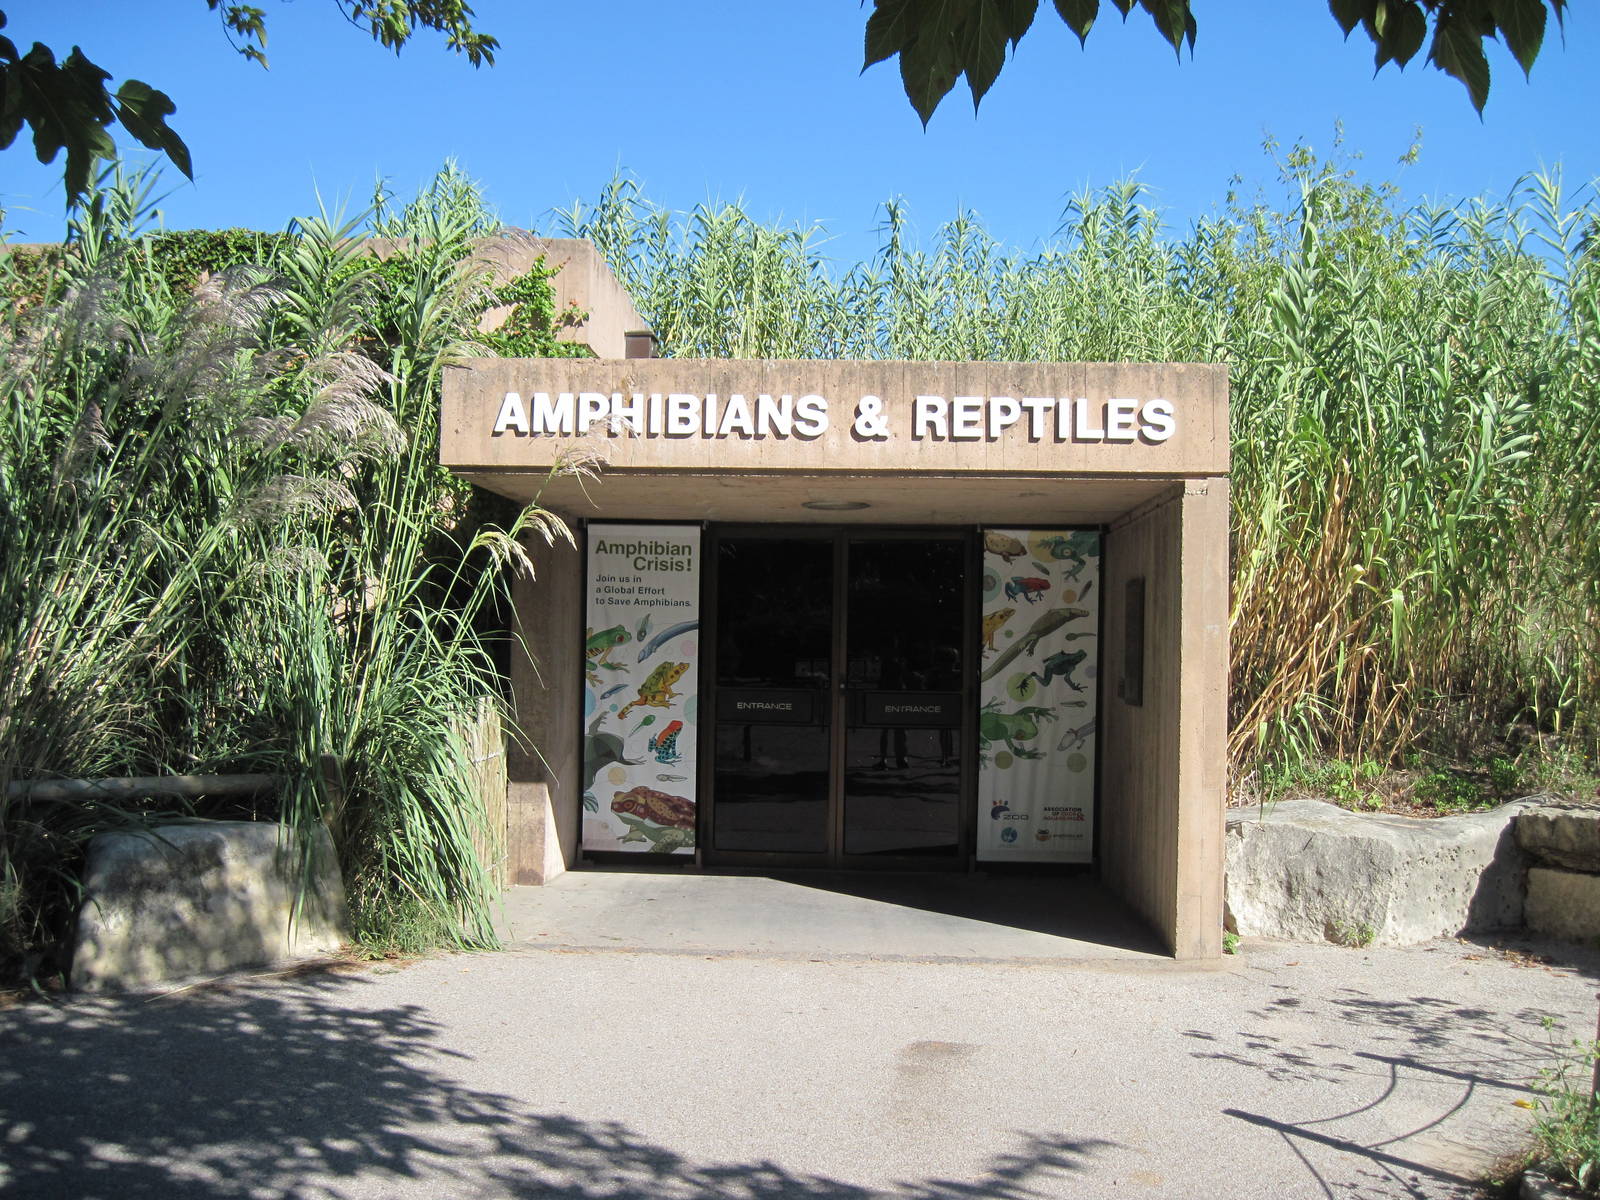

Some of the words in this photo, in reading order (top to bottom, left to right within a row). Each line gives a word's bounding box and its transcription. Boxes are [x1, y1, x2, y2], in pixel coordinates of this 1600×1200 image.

[492, 391, 830, 440] AMPHIBIANS
[852, 395, 889, 440] &
[913, 395, 1176, 443] REPTILES
[595, 540, 692, 558] Amphibian
[633, 556, 692, 572] Crisis!
[596, 575, 616, 583] Join
[633, 575, 642, 583] in
[604, 586, 635, 595] Global
[638, 586, 665, 595] Effort
[596, 597, 605, 605] to
[607, 597, 631, 606] Save
[633, 598, 692, 608] Amphibians.
[736, 701, 793, 711] ENTRANCE
[884, 704, 942, 714] ENTRANCE
